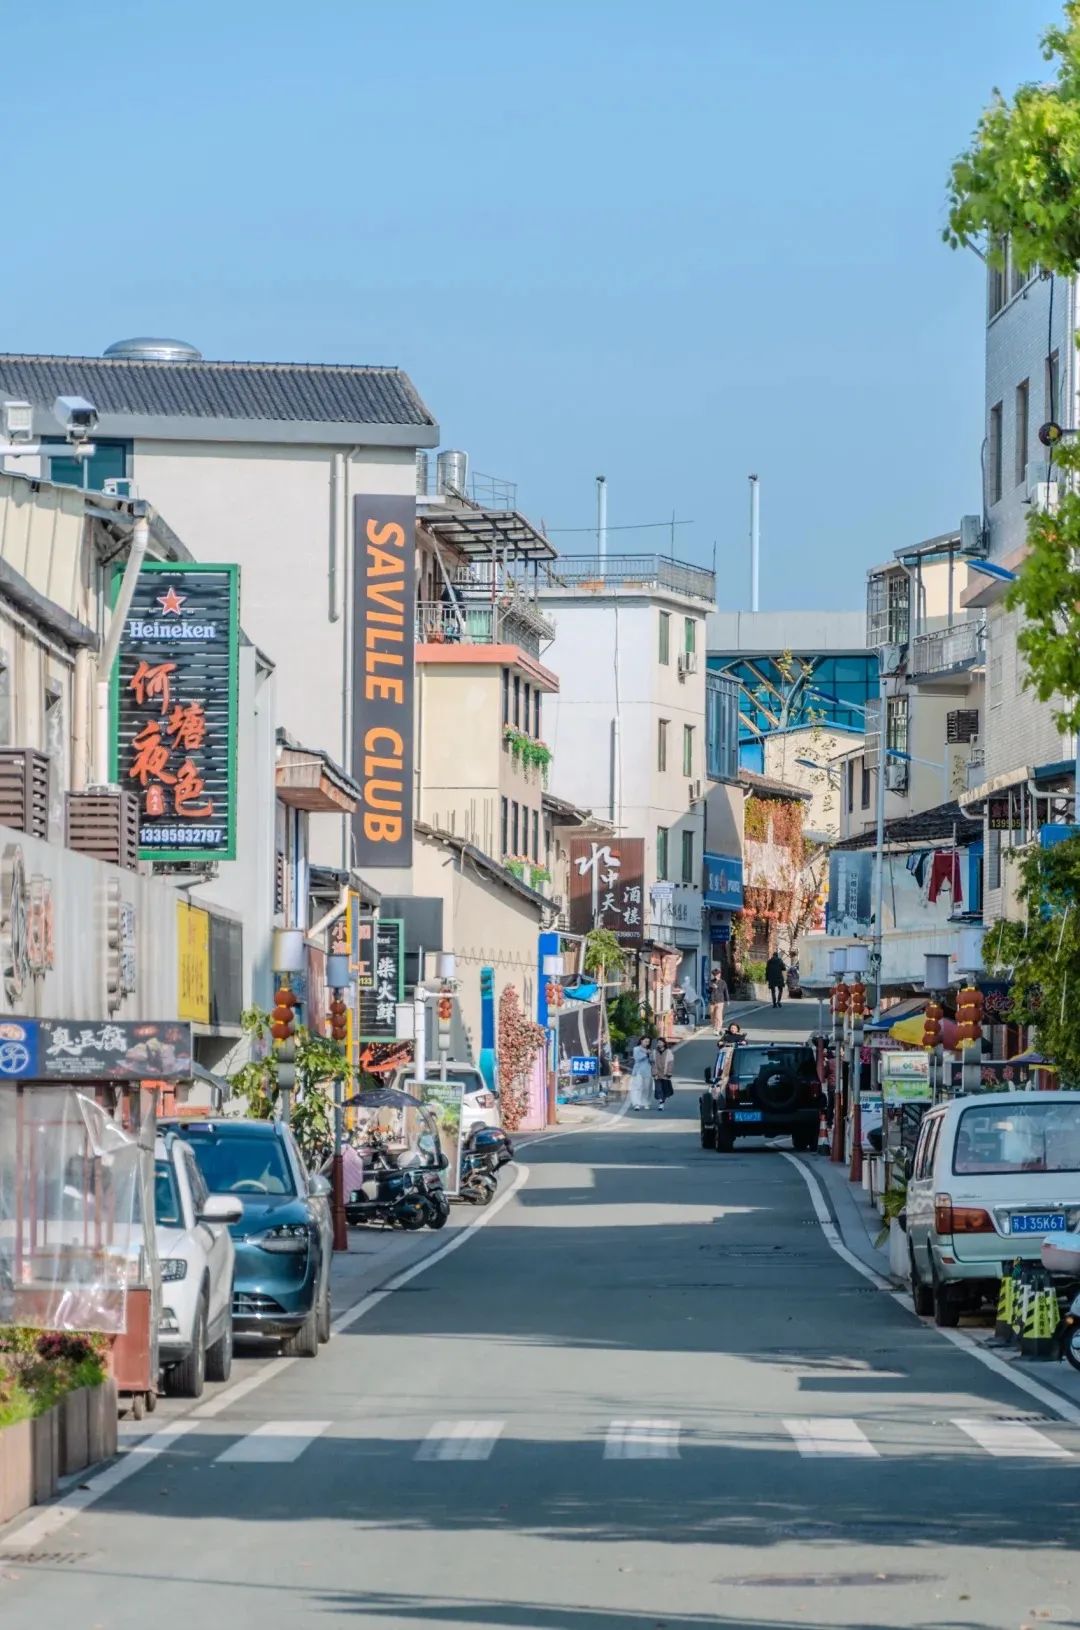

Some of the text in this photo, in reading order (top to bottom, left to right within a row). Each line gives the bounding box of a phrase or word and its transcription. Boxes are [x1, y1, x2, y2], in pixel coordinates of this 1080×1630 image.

[129, 621, 216, 639] Heineken
[363, 518, 406, 843] SAVILLE CLUB
[139, 828, 222, 844] 13395932797
[622, 886, 642, 925] 酒楼
